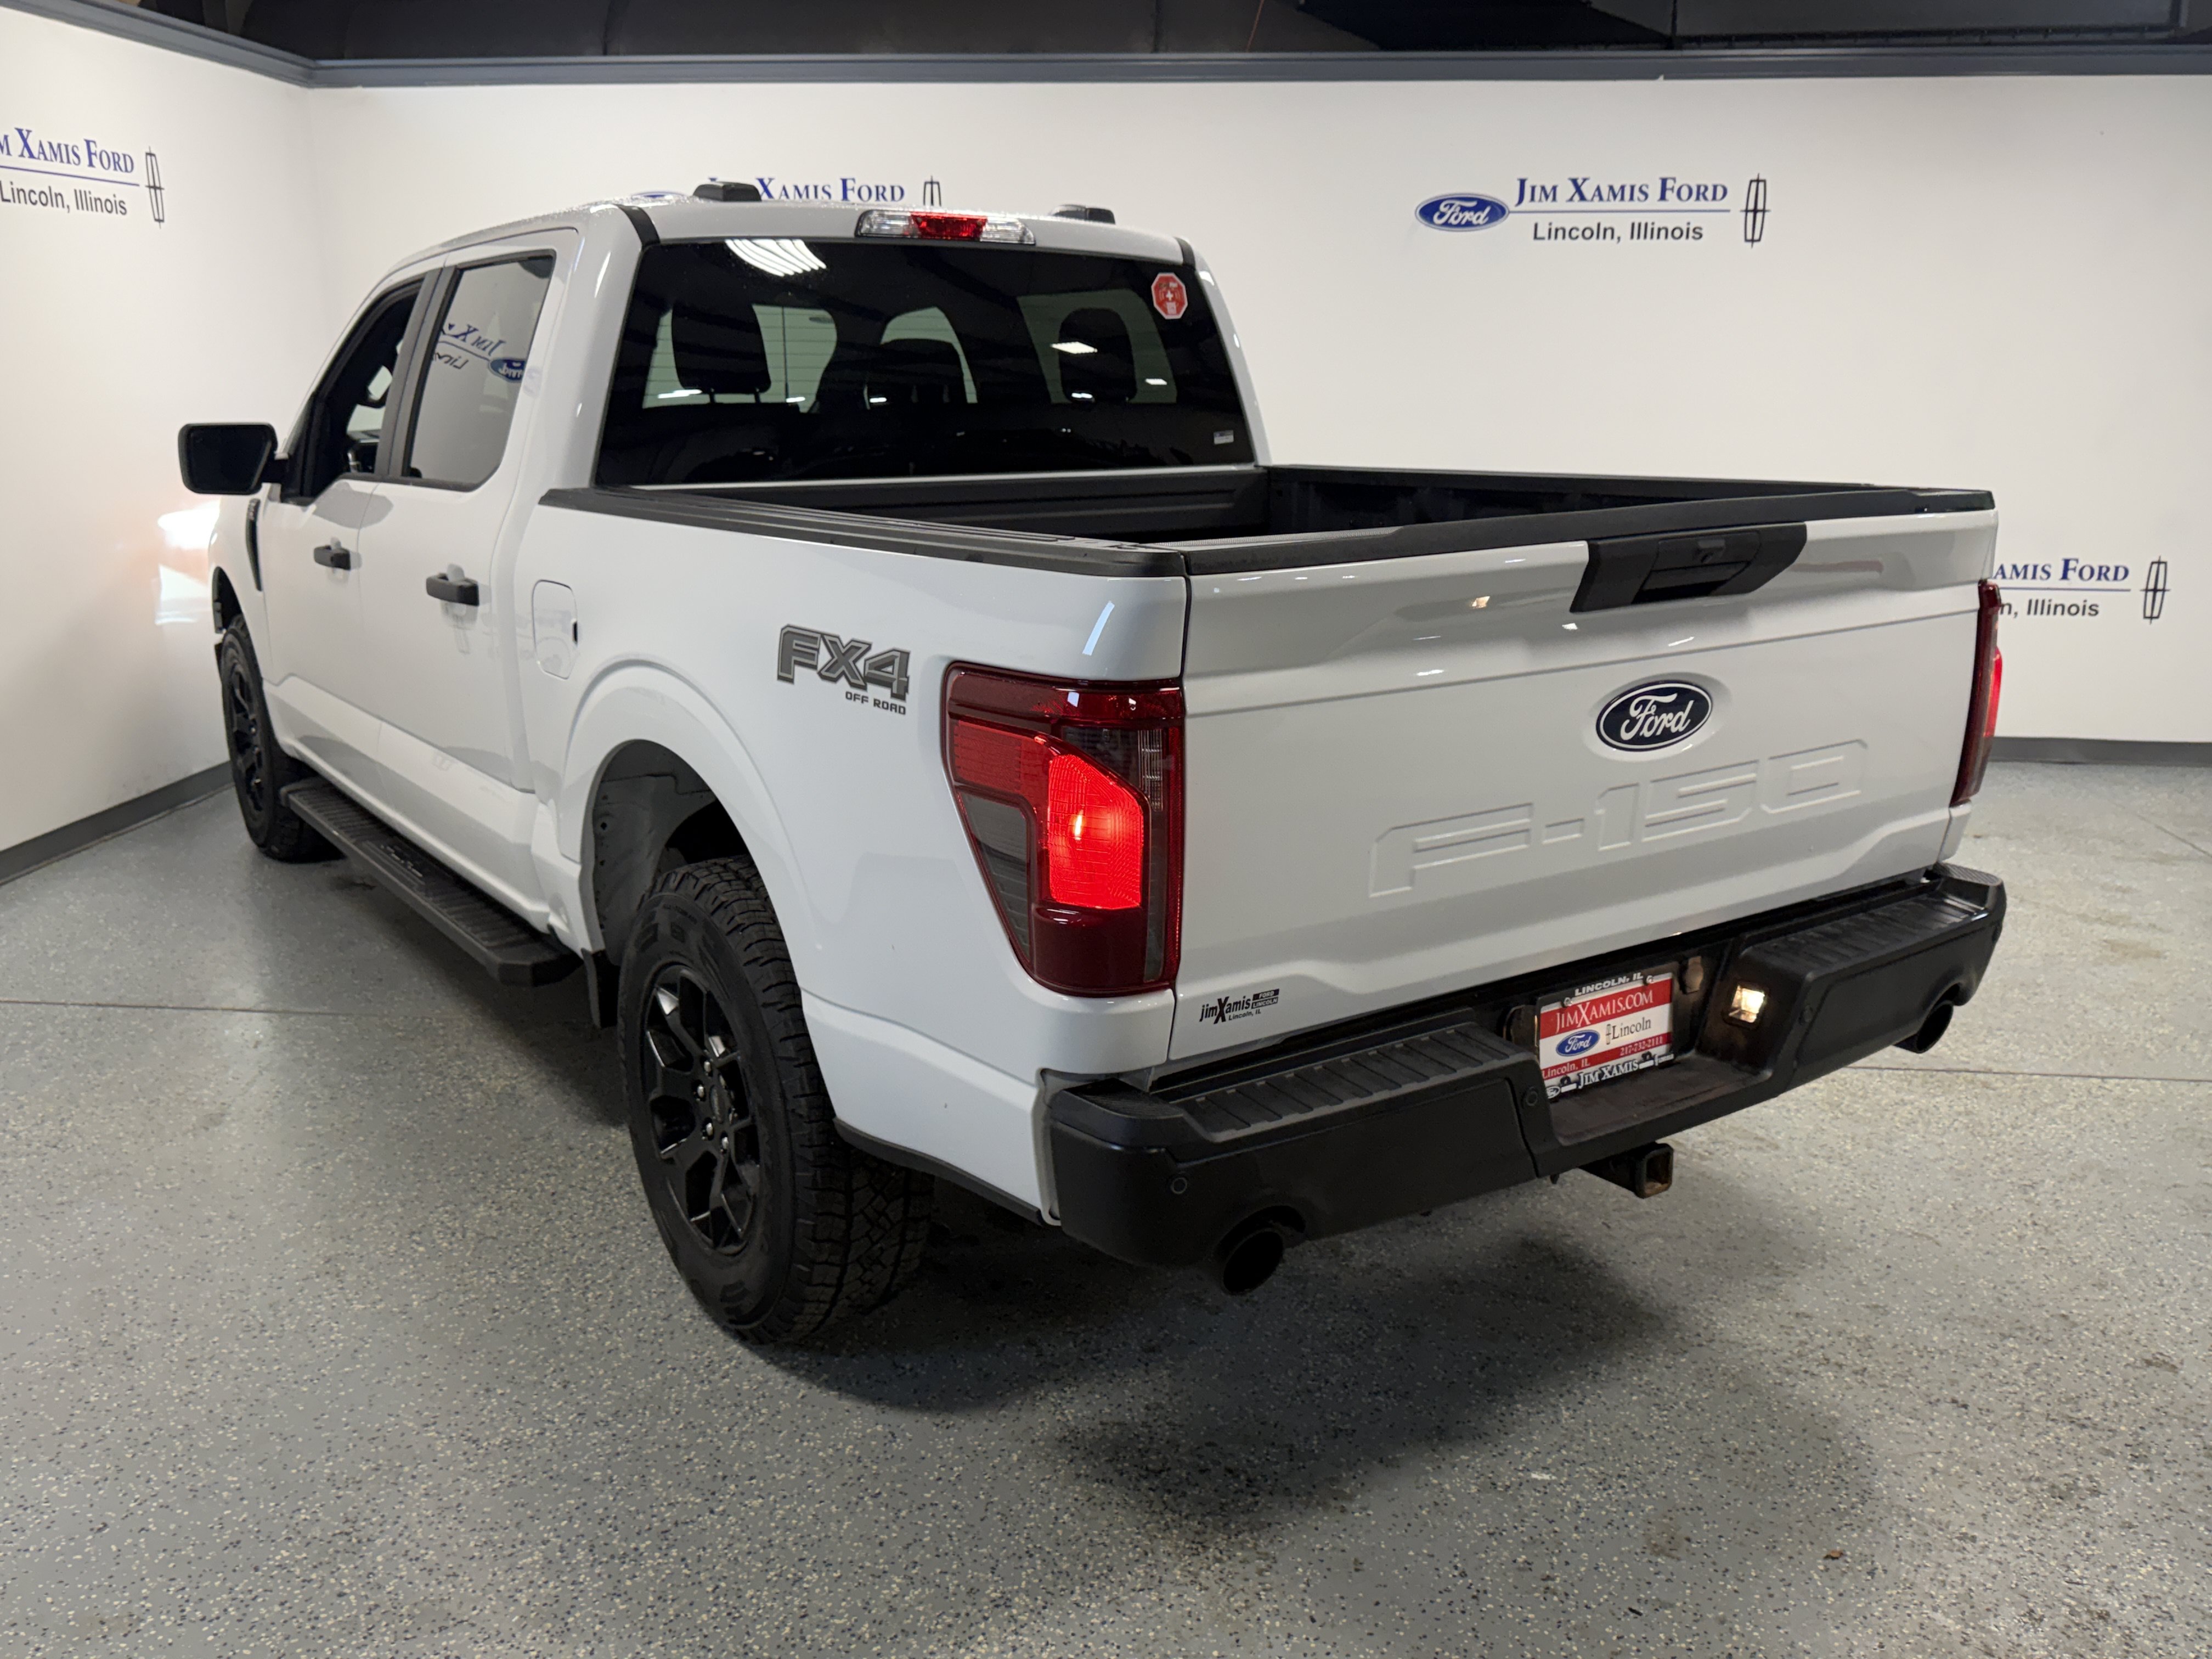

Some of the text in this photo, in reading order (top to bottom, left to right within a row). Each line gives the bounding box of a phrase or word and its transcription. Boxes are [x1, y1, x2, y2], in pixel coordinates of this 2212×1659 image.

[14, 127, 81, 166] XAMIS
[83, 138, 134, 173] FORD
[0, 180, 127, 216] Lincoln, Illinois
[755, 177, 905, 202] XAMIS FORD
[1515, 177, 1728, 207] JIM XAMIS FORD
[1434, 200, 1489, 225] Ford
[1533, 222, 1703, 243] Lincoln, Illinois
[1993, 557, 2129, 582] AMIS FORD
[2027, 599, 2099, 616] Illinois
[777, 624, 911, 702] FX4
[845, 691, 906, 715] OFF ROAD
[1620, 693, 1694, 740] Ford
[1369, 739, 1869, 898] F-150
[1633, 972, 1644, 980] IL
[1253, 997, 1277, 1008] LINCOLN
[1259, 991, 1274, 999] FORD
[1612, 1017, 1651, 1040] Lincoln
[1565, 1034, 1591, 1053] Ford
[1578, 1071, 1600, 1089] JIM
[1601, 1059, 1639, 1081] XAMIS
[1582, 1059, 1590, 1067] IL
